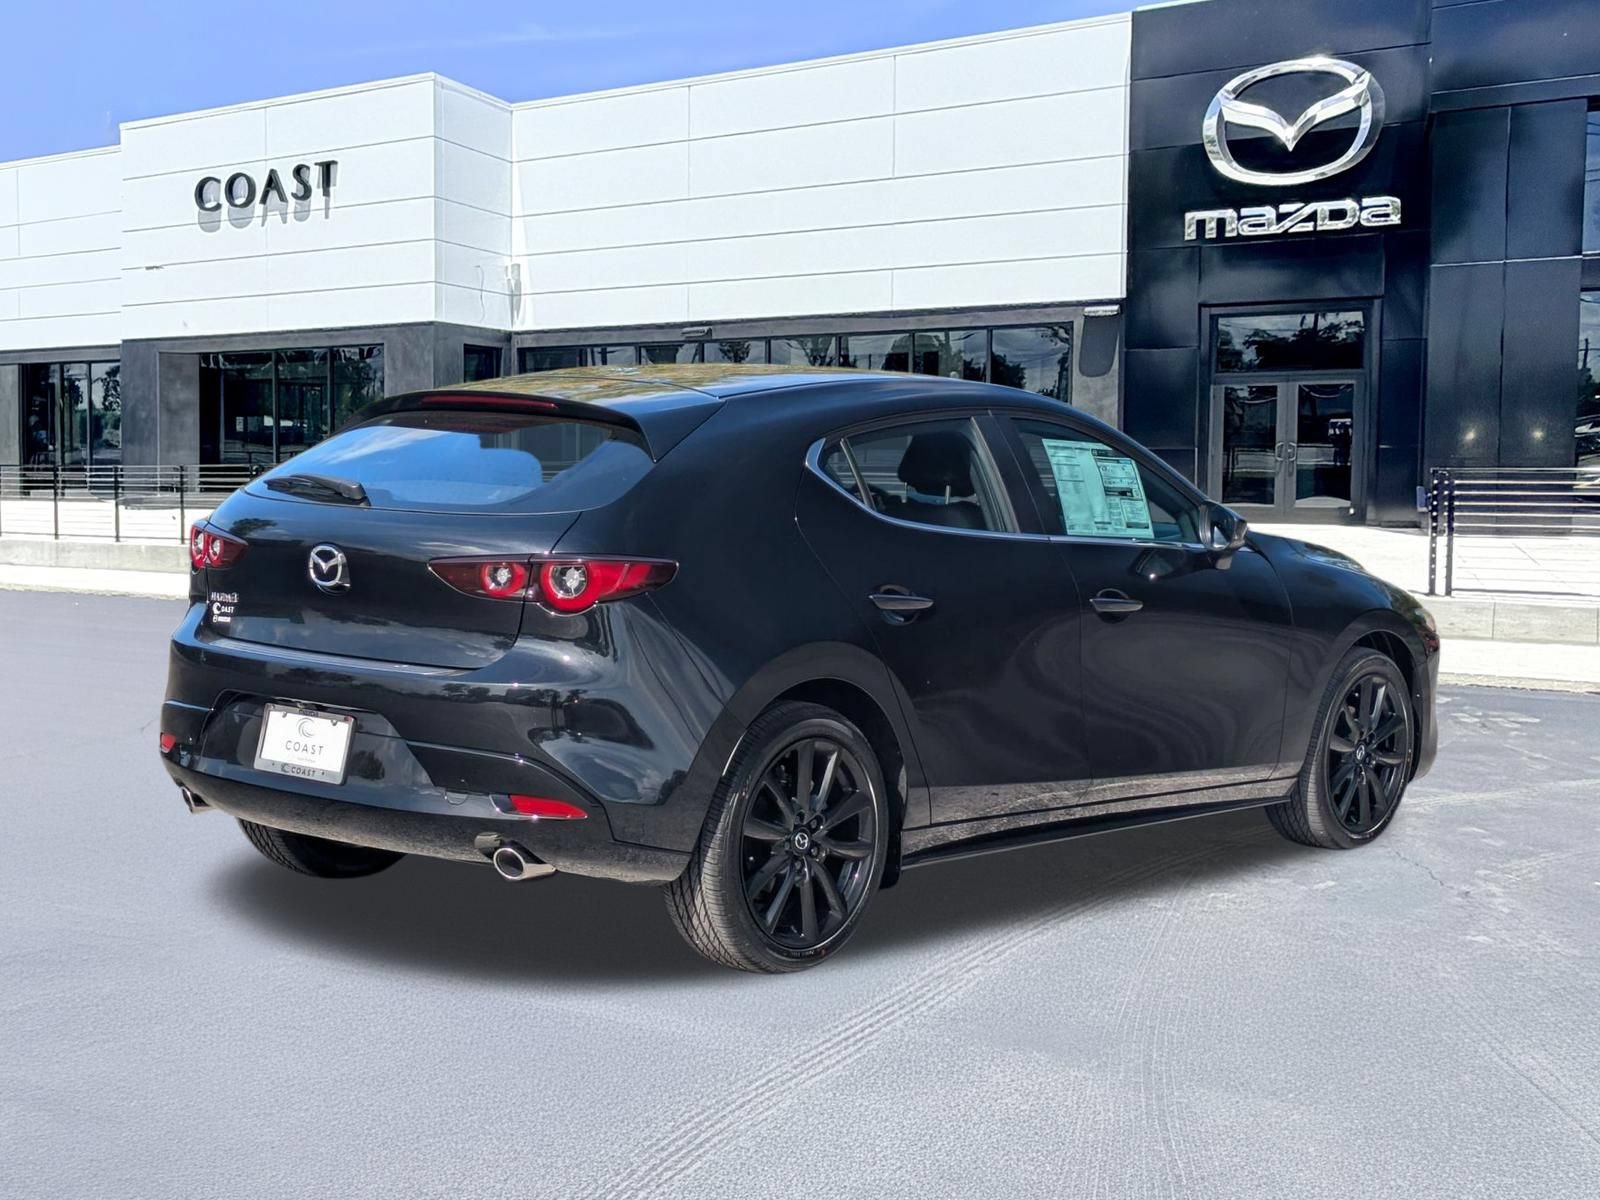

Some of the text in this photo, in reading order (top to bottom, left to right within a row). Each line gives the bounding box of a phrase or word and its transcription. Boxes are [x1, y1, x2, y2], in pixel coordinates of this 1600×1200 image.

[194, 160, 338, 212] COAST
[1184, 195, 1402, 241] mazda
[285, 740, 324, 756] COAST
[291, 766, 316, 778] COAST
